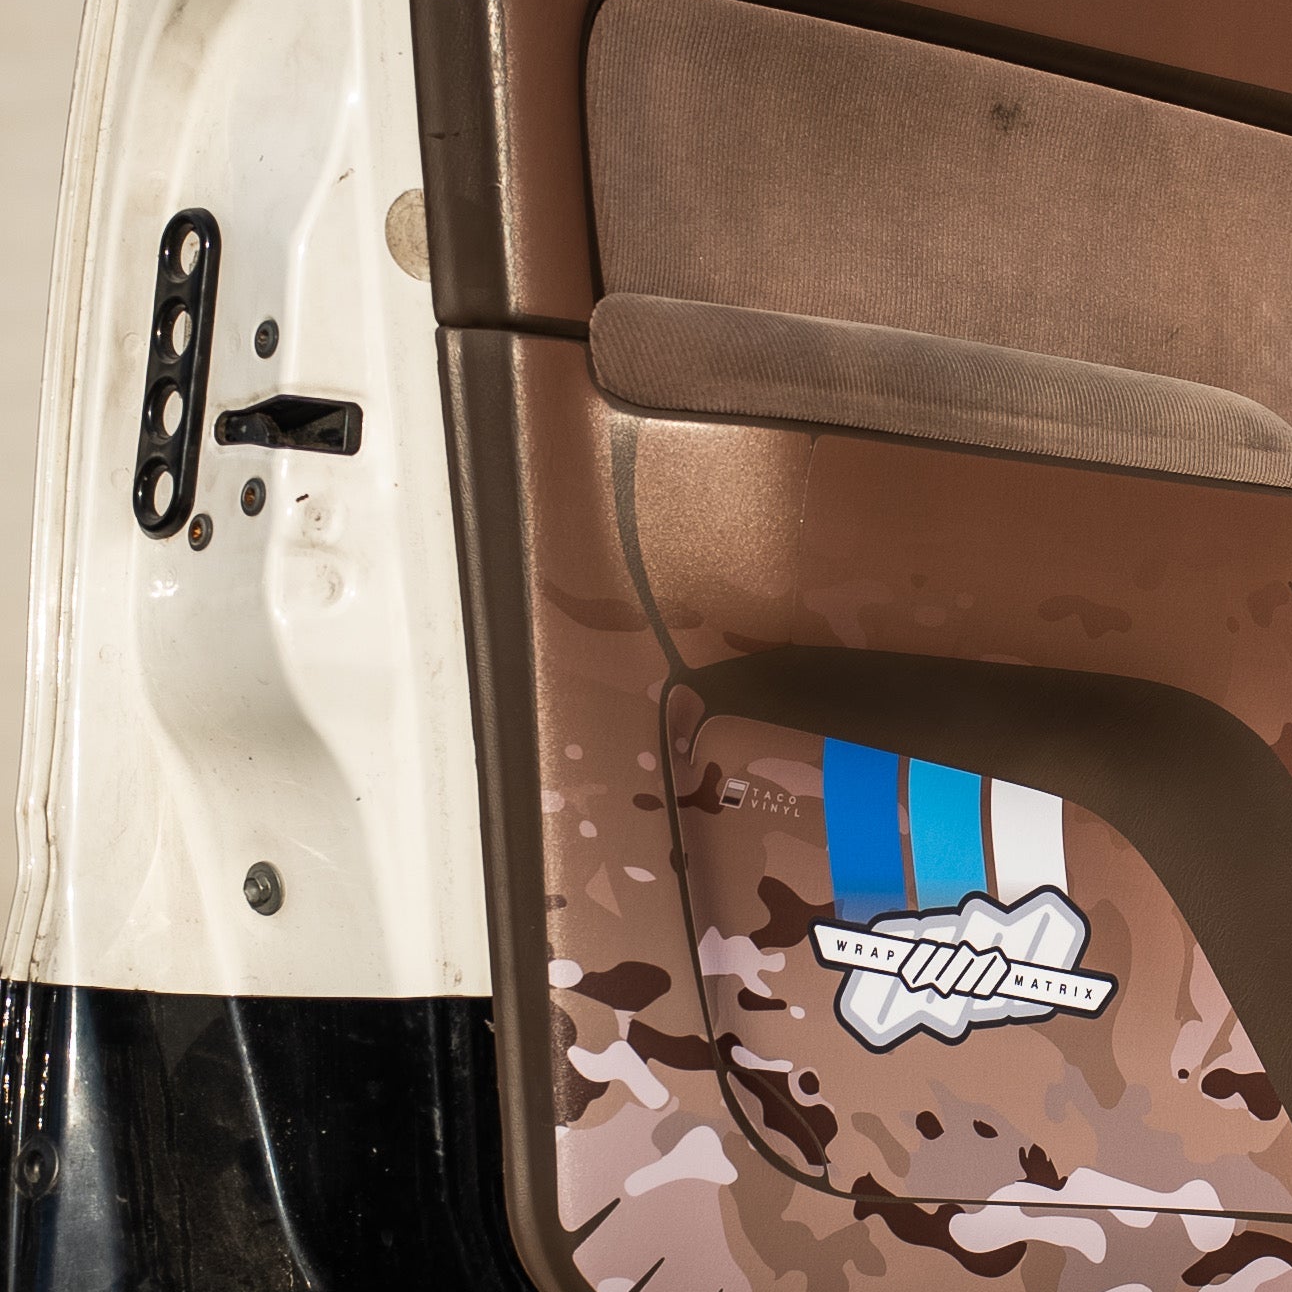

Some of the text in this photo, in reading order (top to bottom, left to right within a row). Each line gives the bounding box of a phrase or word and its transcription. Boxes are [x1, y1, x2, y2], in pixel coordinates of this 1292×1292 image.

[752, 787, 797, 805] TACO
[751, 799, 801, 818] VINYL
[836, 939, 895, 961] WRAP
[1014, 974, 1093, 1000] MATRIX
